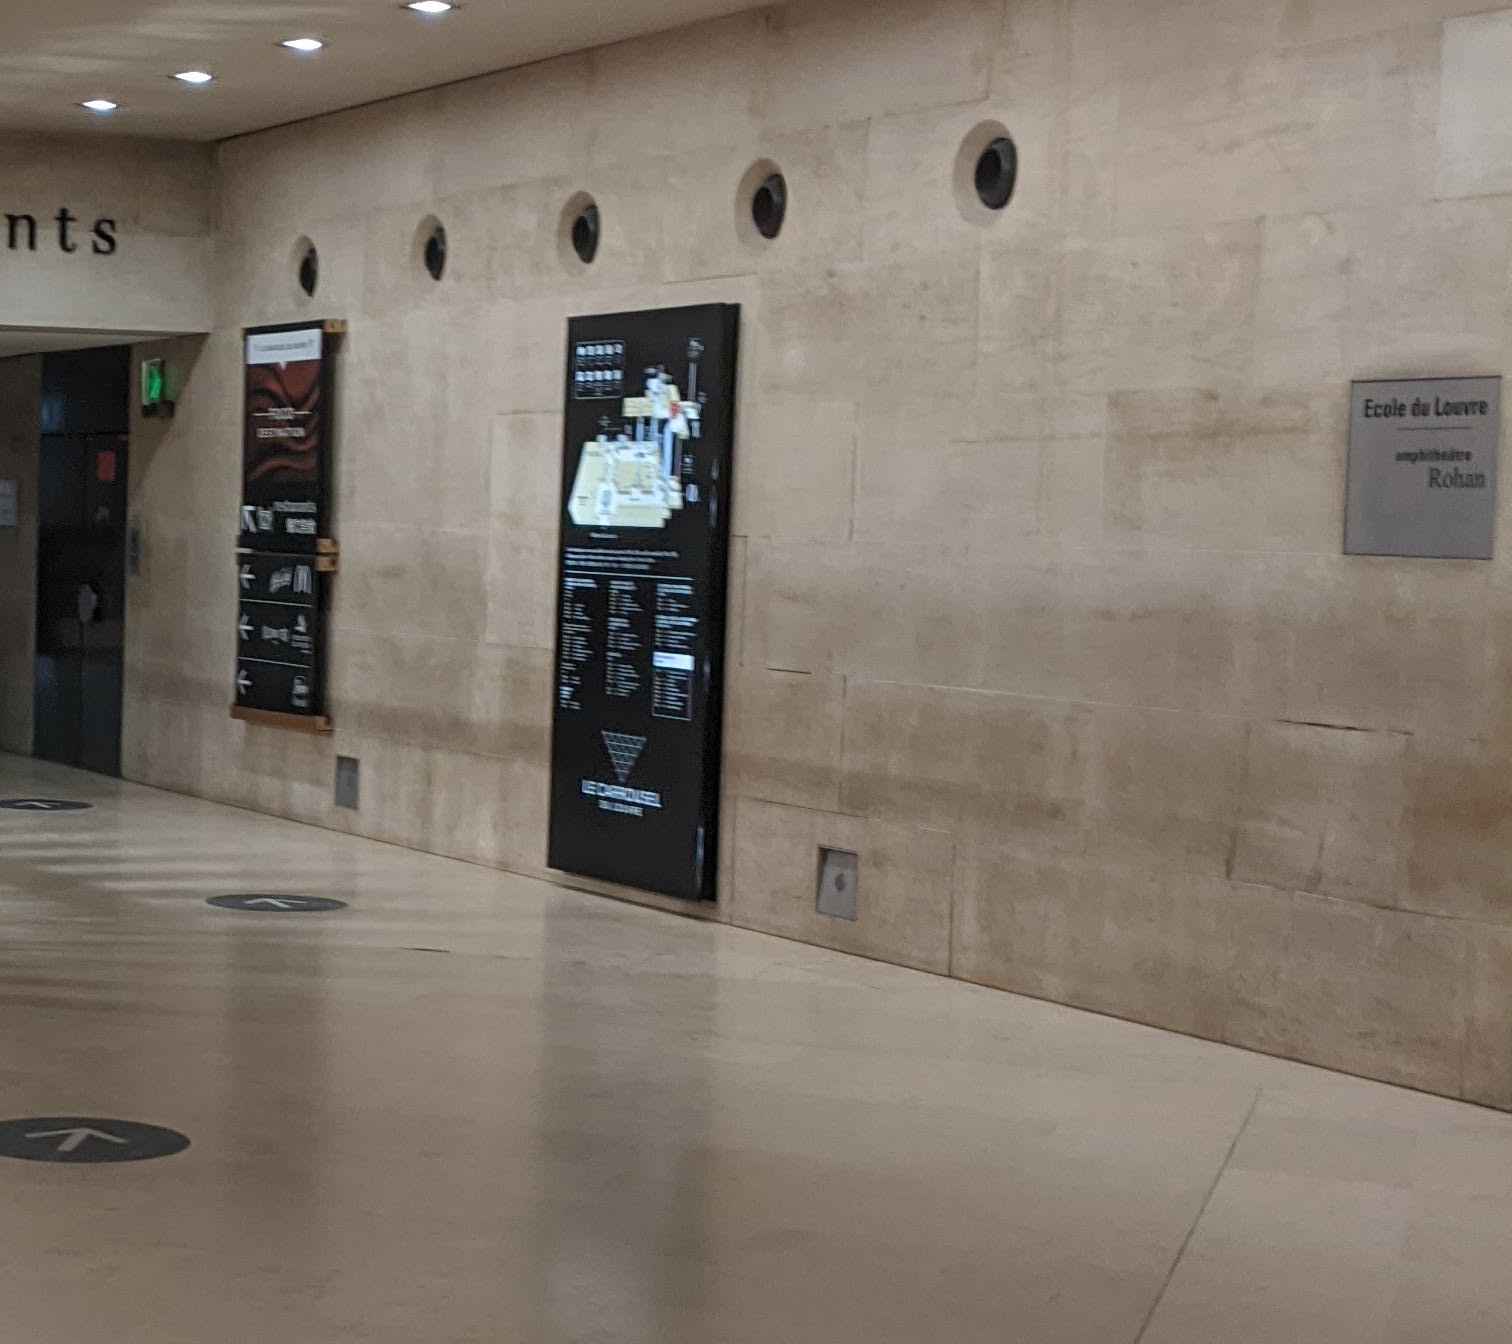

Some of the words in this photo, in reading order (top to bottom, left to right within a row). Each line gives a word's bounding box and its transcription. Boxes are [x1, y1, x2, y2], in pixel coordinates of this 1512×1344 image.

[1363, 397, 1407, 419] Ecole
[1410, 396, 1431, 418] du
[1433, 395, 1489, 418] Louvre
[1427, 466, 1487, 489] Rohan
